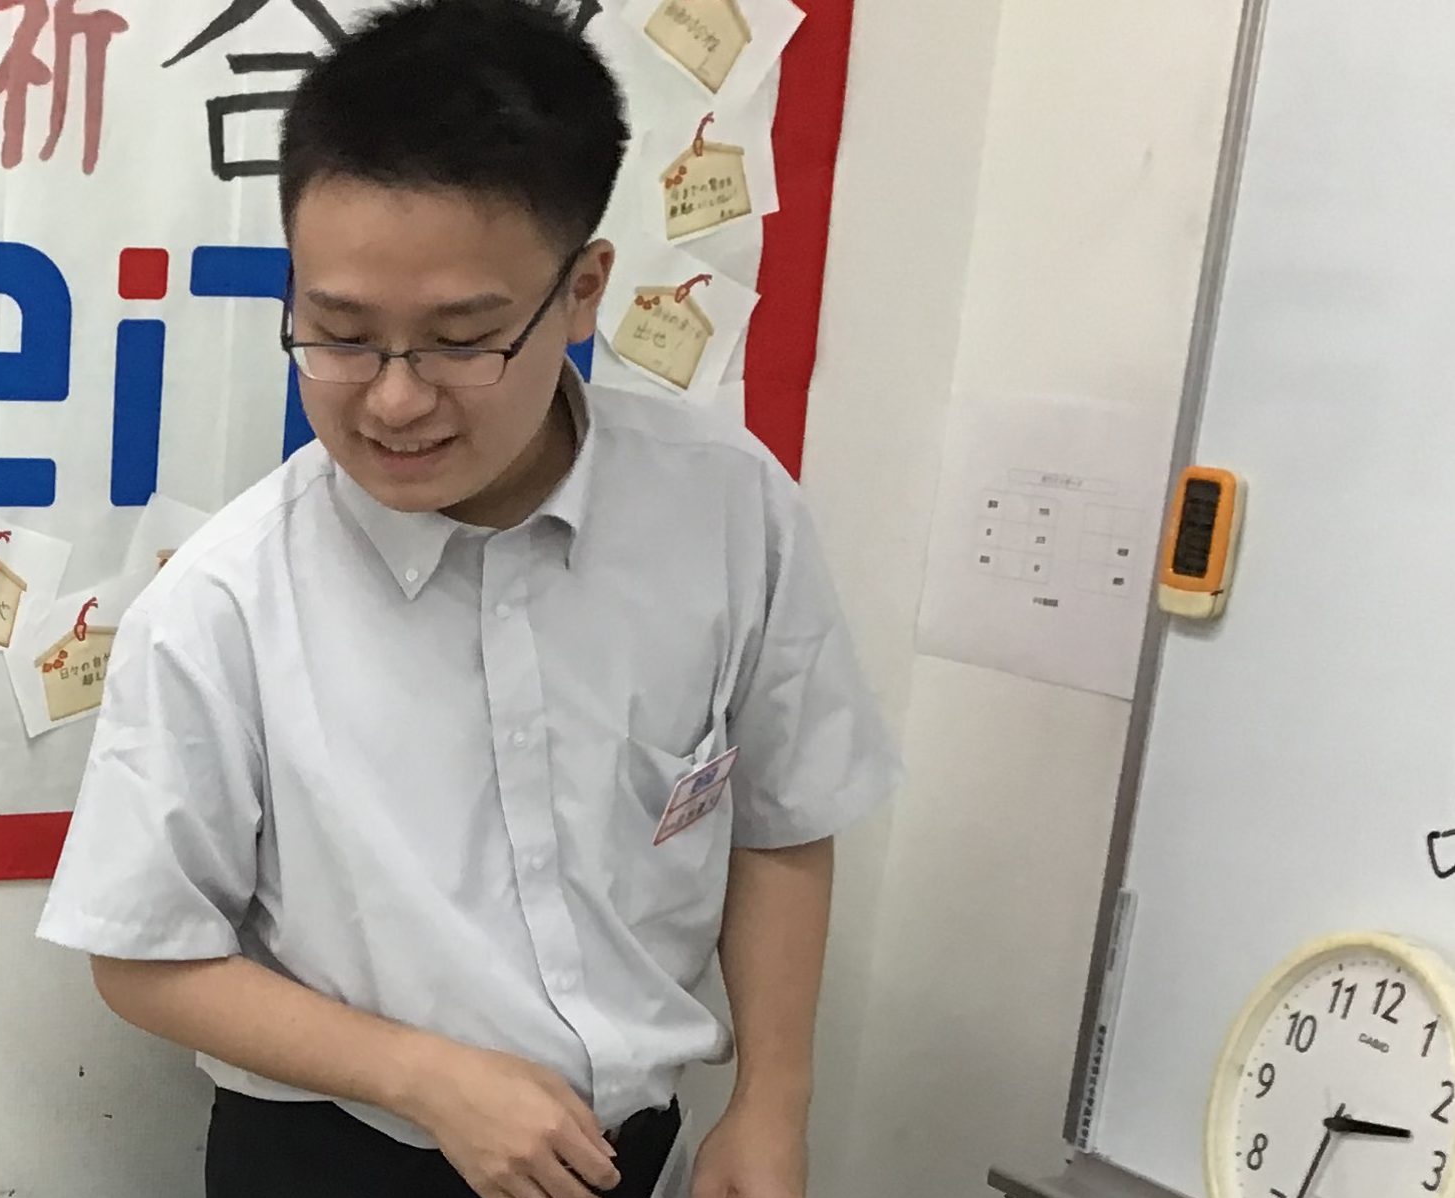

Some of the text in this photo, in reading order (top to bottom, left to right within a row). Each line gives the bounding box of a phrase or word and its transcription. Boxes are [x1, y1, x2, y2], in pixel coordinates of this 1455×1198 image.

[1328, 977, 1358, 1020] 11
[1372, 978, 1407, 1024] 12
[1285, 1010, 1318, 1053] 10
[1358, 1032, 1391, 1053] CASIO
[1421, 1018, 1440, 1058] 1
[1255, 1063, 1276, 1099] 9
[1430, 1080, 1455, 1124] 2
[1246, 1132, 1269, 1171] 8
[1422, 1150, 1447, 1192] 3
